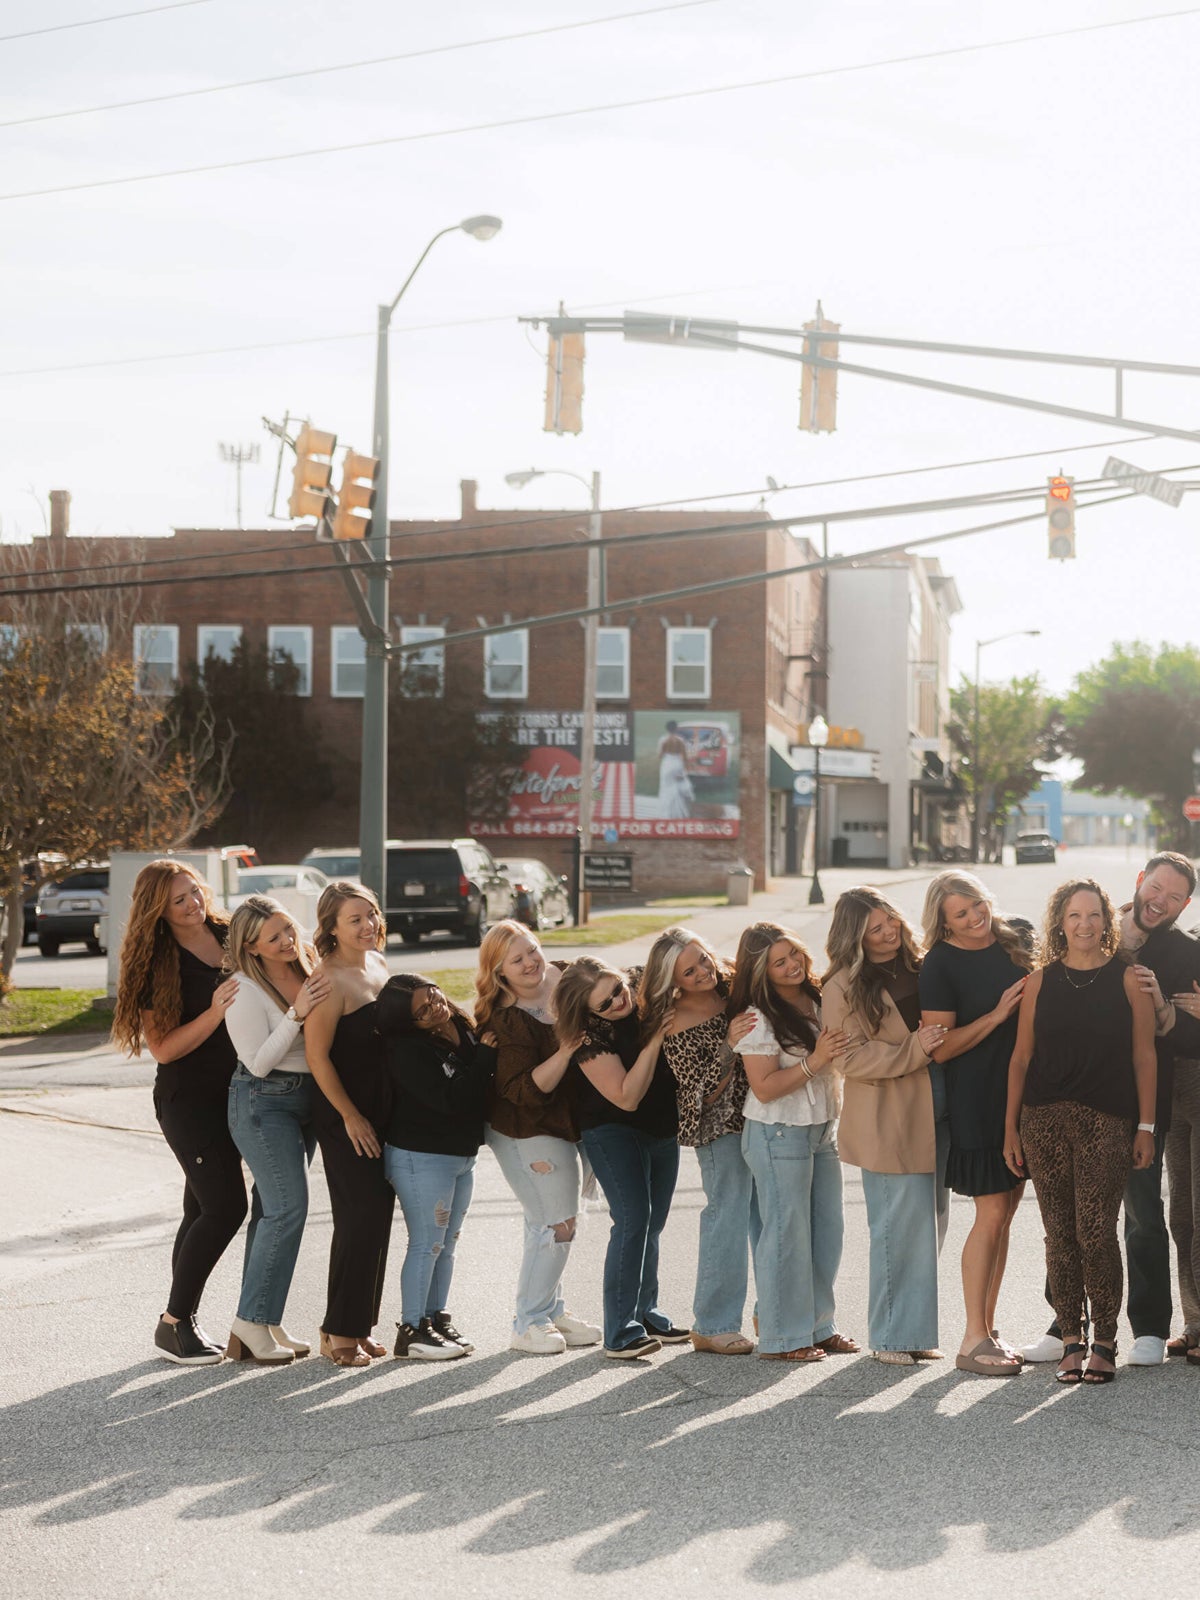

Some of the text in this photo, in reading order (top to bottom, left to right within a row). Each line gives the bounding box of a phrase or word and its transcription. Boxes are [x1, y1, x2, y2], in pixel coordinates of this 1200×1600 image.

[561, 713, 628, 728] CATRING!
[544, 728, 578, 745] THE
[592, 728, 630, 745] EST!
[468, 822, 508, 835] CALL
[619, 822, 651, 835] FOR
[654, 822, 734, 836] CATERING
